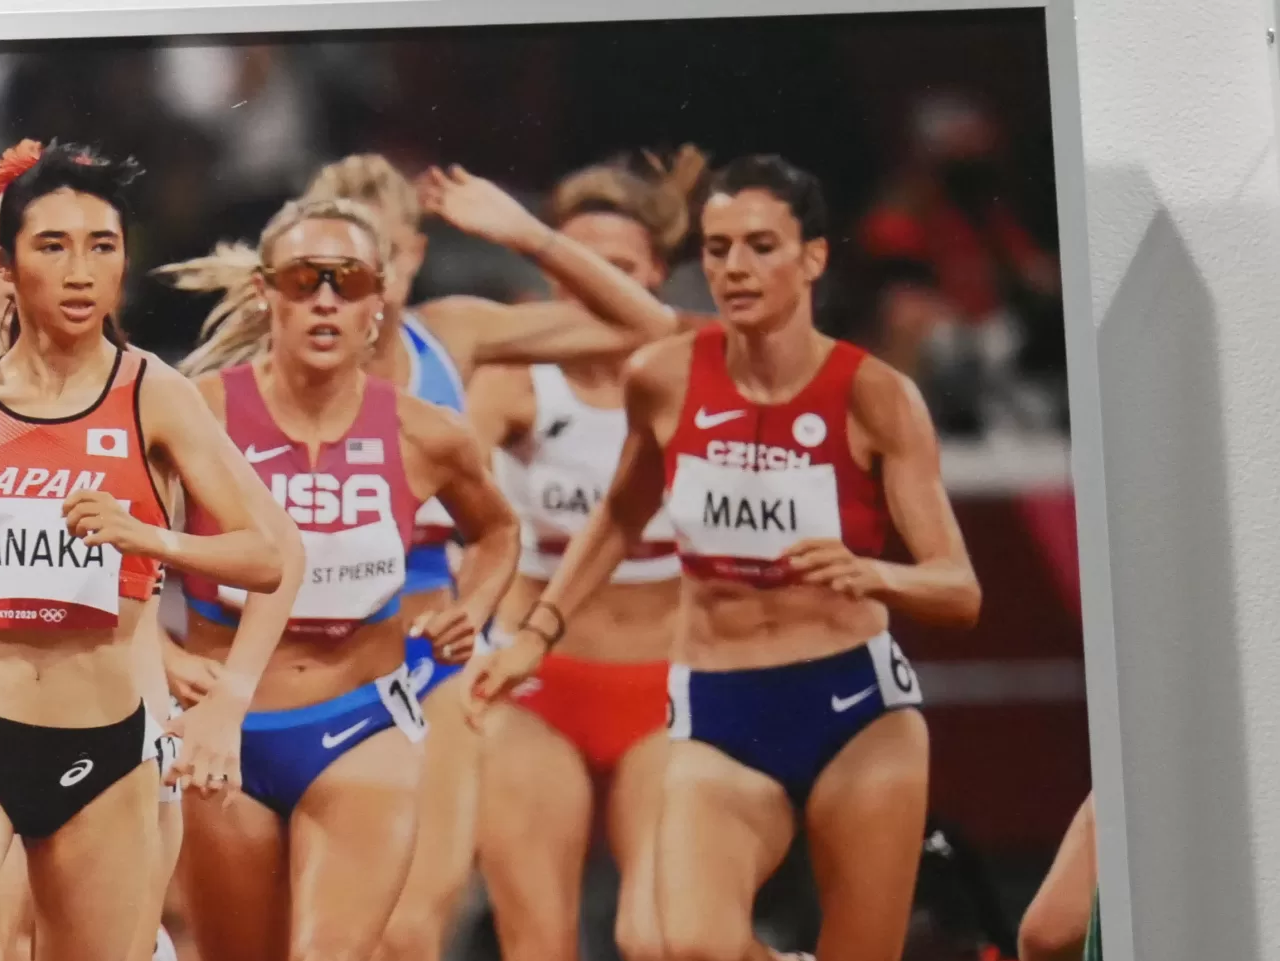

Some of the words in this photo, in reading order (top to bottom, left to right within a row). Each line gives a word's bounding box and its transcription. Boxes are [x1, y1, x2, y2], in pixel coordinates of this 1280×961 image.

[542, 482, 602, 514] GA
[703, 490, 797, 532] MAKI
[312, 566, 333, 584] ST
[338, 557, 398, 583] PIERRE
[15, 610, 37, 619] 2020
